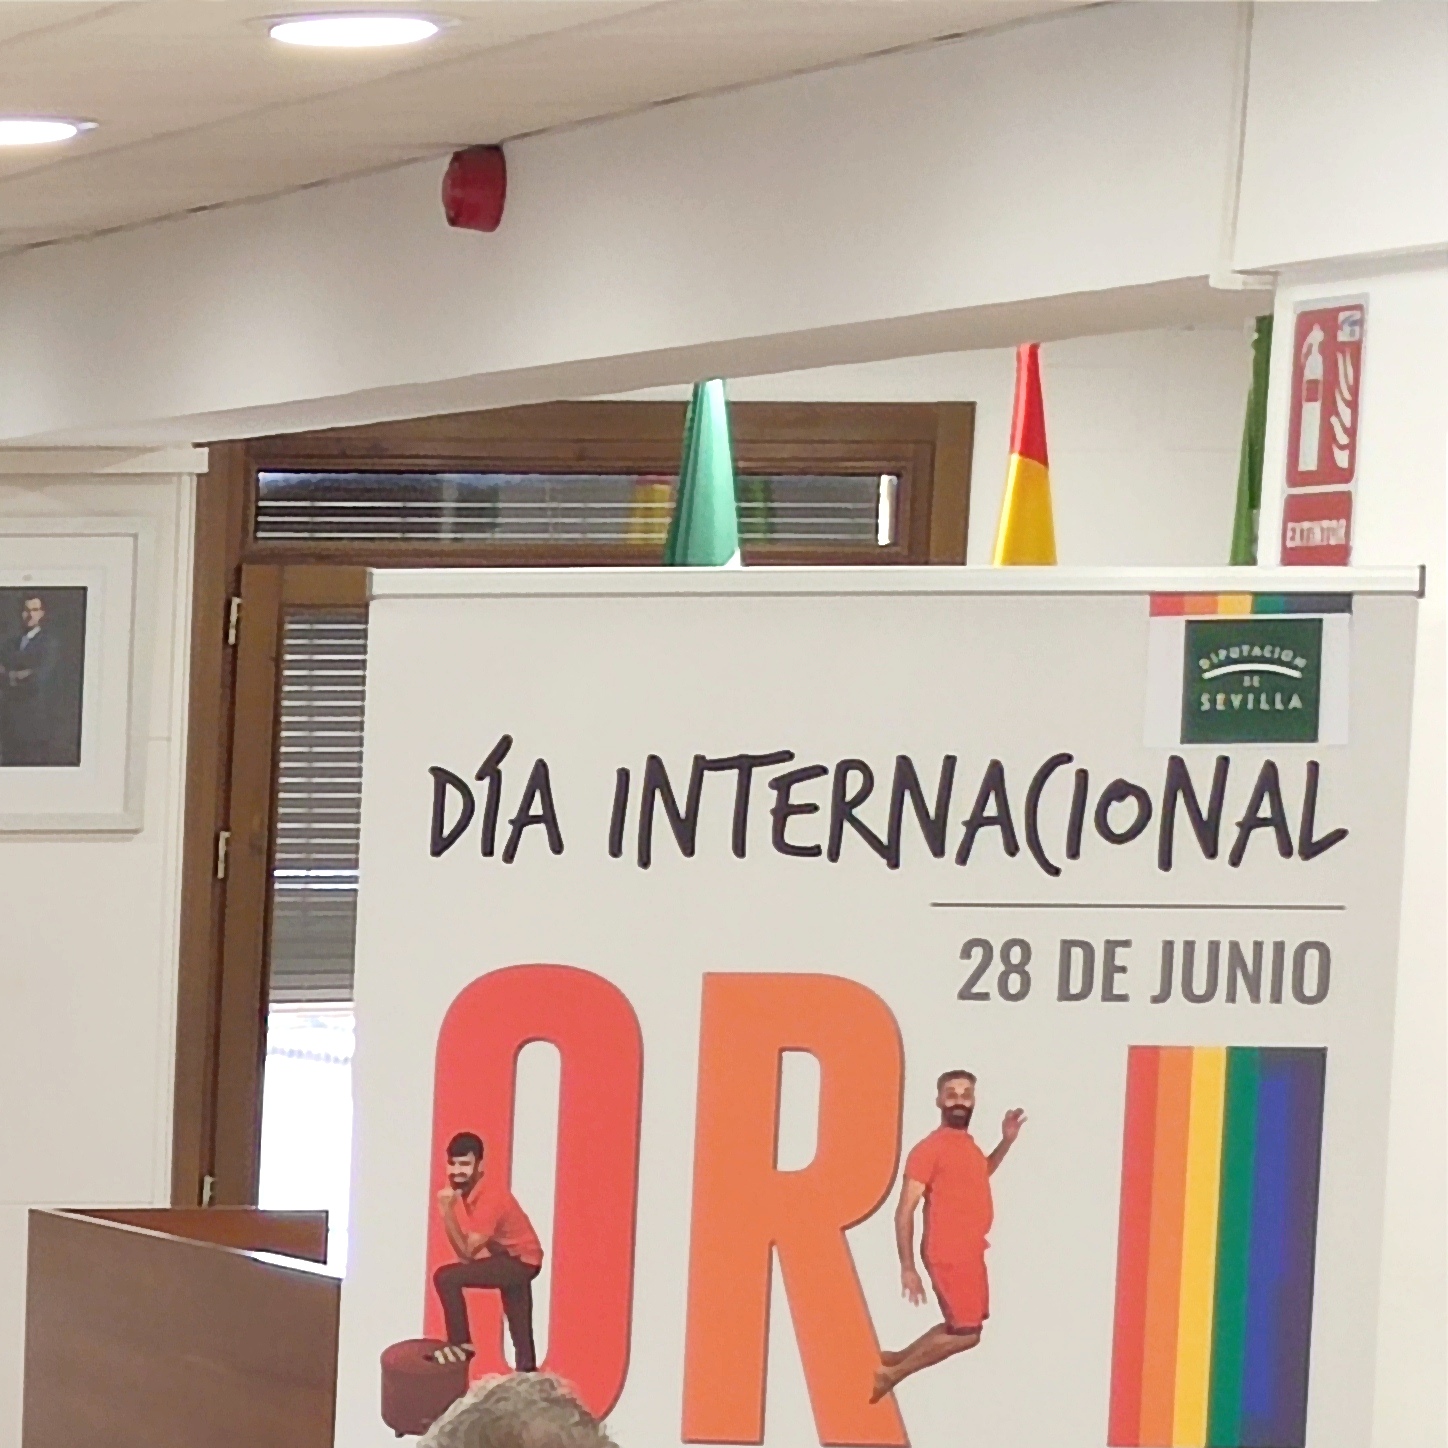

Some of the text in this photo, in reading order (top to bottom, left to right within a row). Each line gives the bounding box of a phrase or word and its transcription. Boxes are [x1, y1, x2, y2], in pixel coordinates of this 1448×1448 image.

[1200, 691, 1303, 712] SEVILLA
[426, 734, 1349, 877] DÍA INTERNACIONAL
[956, 936, 1333, 1006] 28 DE JUNIO
